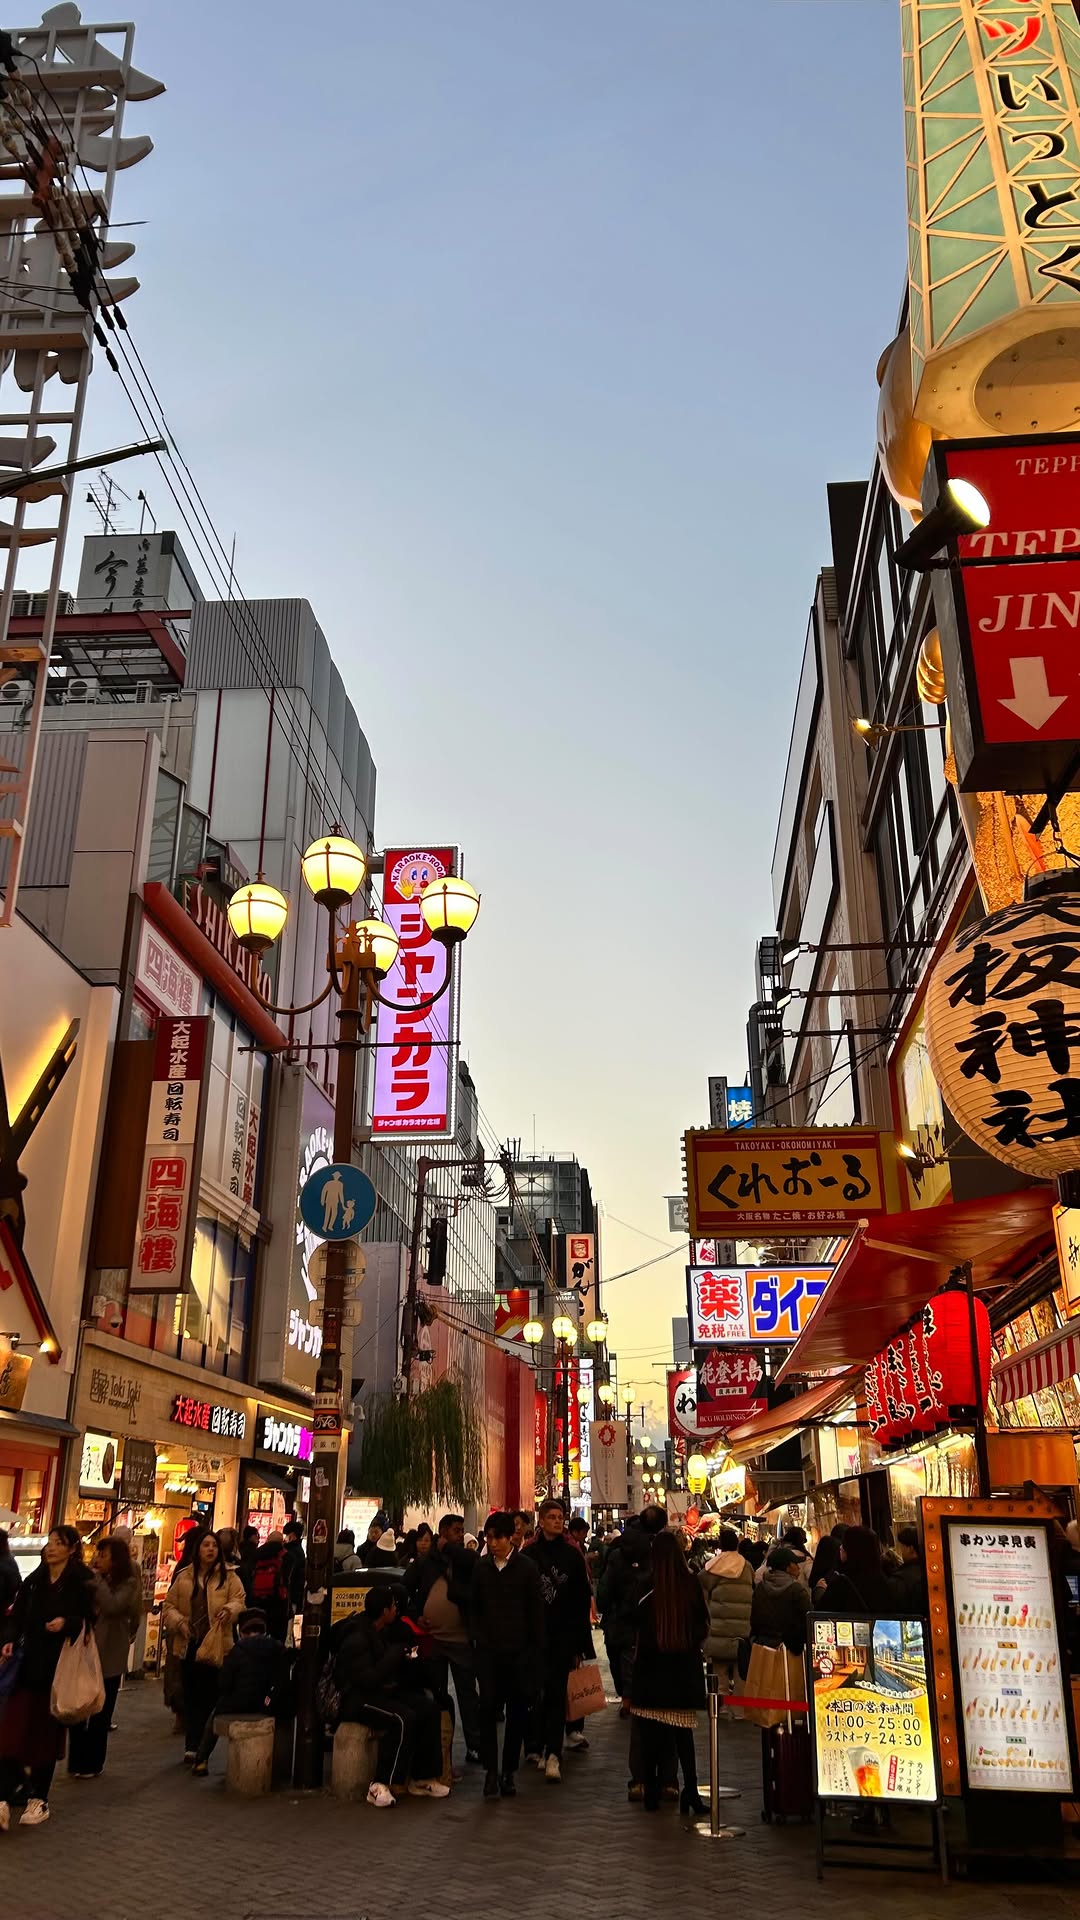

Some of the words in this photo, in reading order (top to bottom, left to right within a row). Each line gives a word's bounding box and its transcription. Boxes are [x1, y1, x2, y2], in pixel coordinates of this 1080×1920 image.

[168, 1020, 191, 1079] 大起水産
[163, 1081, 184, 1142] 回転寿司
[728, 1099, 753, 1122] 焼
[707, 1151, 872, 1209] くれおーる
[695, 1270, 743, 1320] 薬
[697, 1323, 726, 1338] 免税
[699, 1357, 764, 1386] 能登半島
[175, 1395, 211, 1431] 大起水産
[212, 1405, 247, 1440] 回転寿司
[959, 1532, 1037, 1549] 串カツ早見表
[830, 1699, 914, 1716] 本日の営業時間
